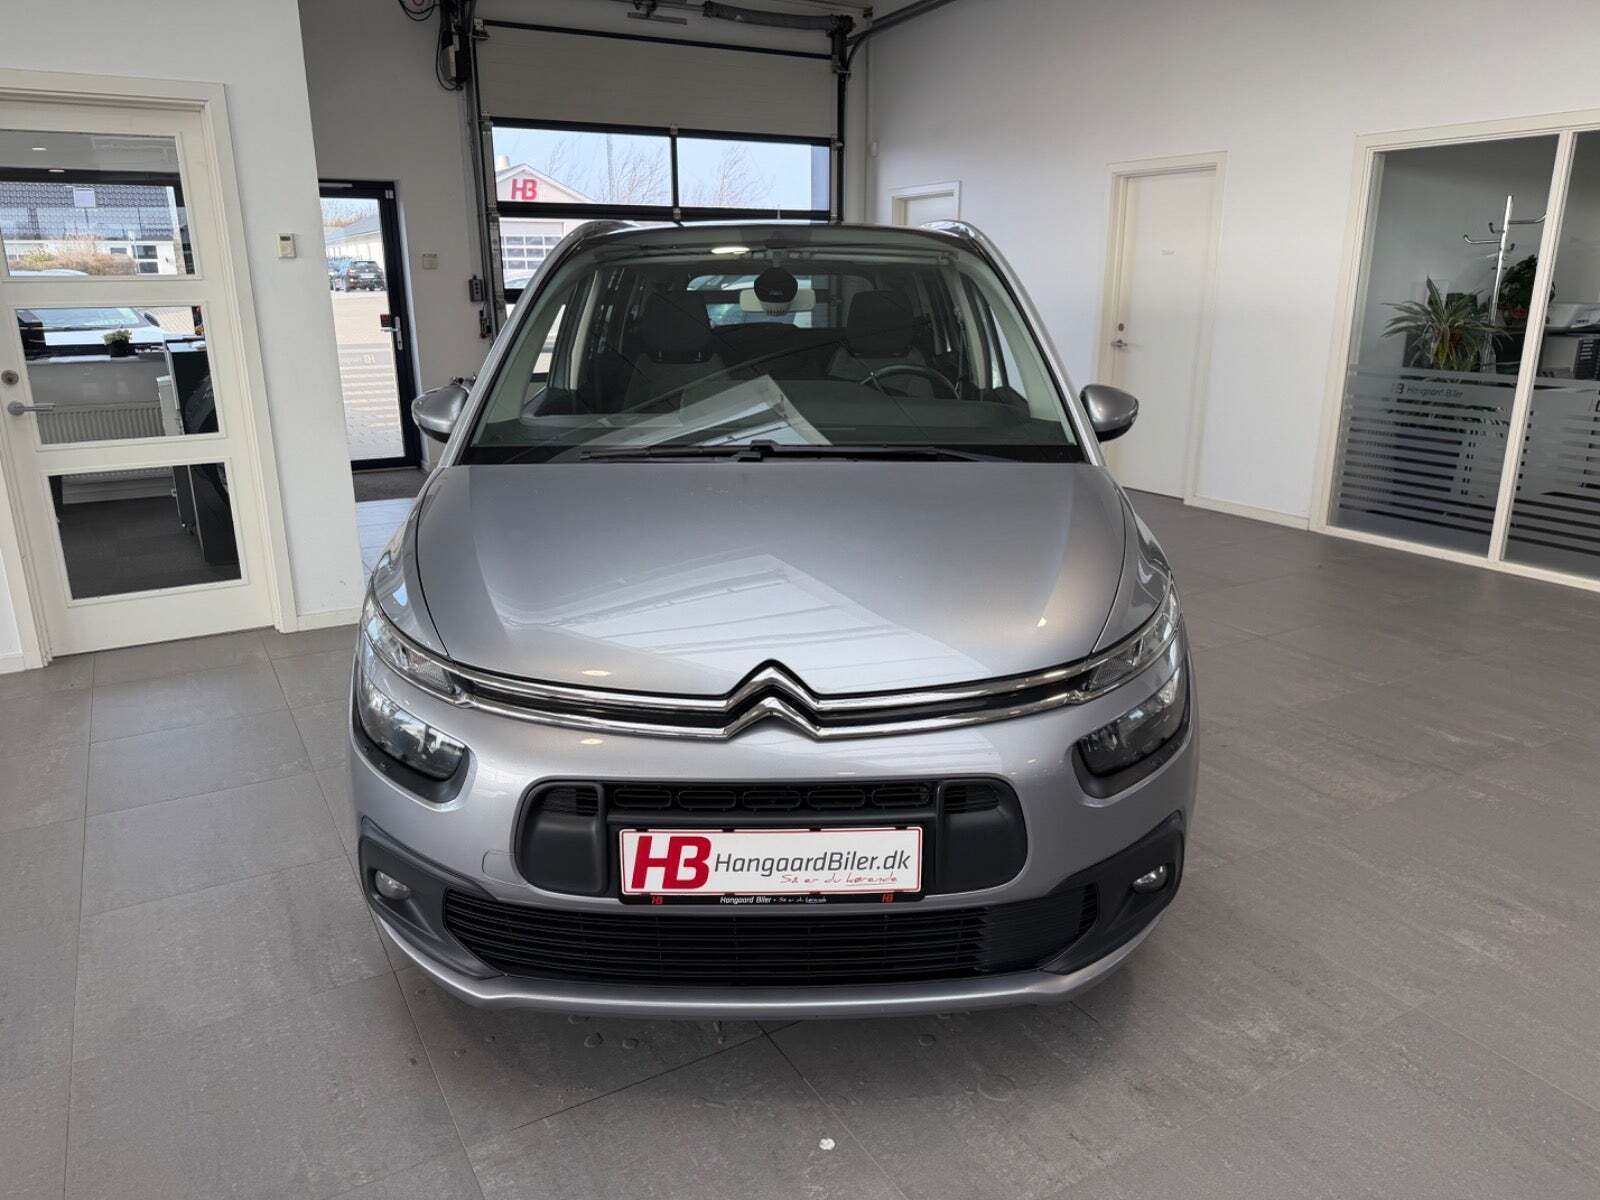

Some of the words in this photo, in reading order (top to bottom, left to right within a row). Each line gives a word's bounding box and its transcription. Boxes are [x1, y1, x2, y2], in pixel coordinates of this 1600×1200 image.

[511, 179, 537, 200] HB
[631, 835, 712, 889] HB
[714, 850, 911, 877] HangaardBiler.dk
